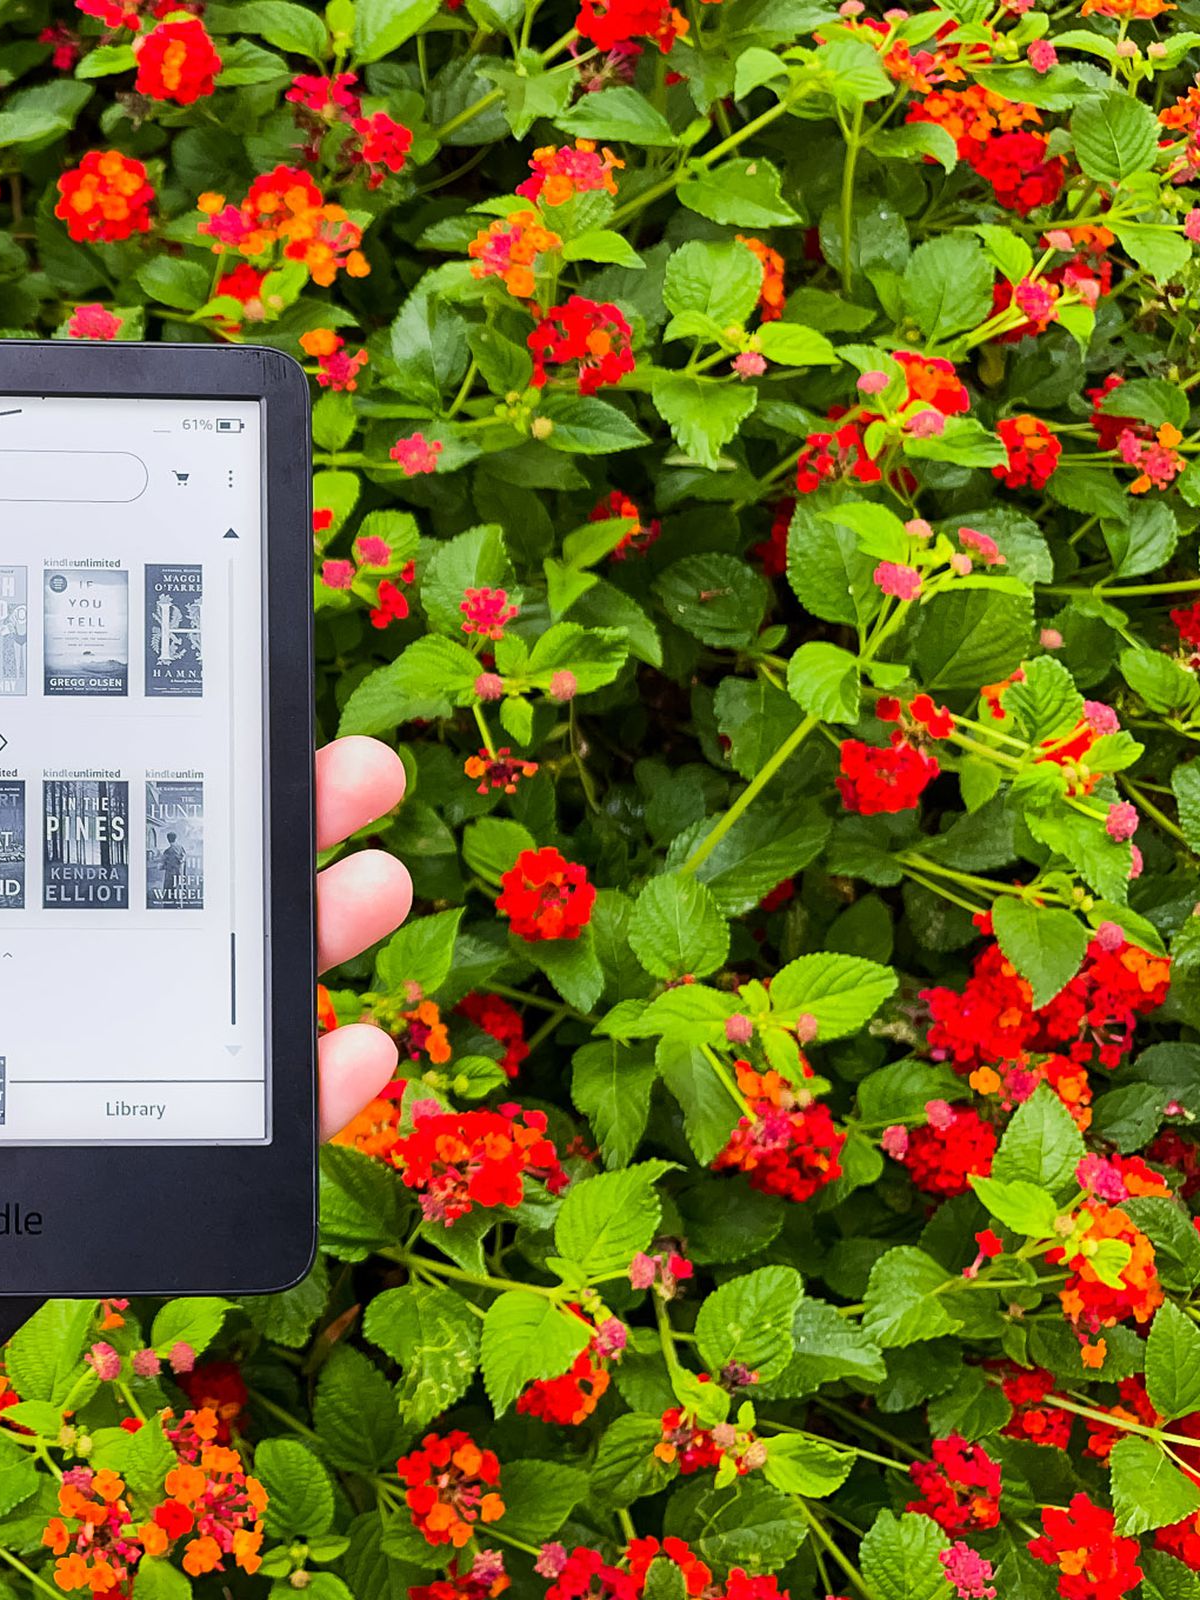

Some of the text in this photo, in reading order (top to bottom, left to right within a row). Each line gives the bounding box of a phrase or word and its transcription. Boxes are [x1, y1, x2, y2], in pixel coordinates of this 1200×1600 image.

[182, 419, 213, 430] 61%
[43, 559, 121, 568] kindleunlimited
[79, 580, 94, 589] IF
[69, 599, 102, 609] YOU
[67, 617, 105, 628] TELL
[153, 669, 202, 678] HAMN
[49, 678, 122, 687] GREGG OLSEN
[43, 769, 121, 778] kindleunlimited
[63, 797, 109, 811] IN THE
[46, 816, 125, 841] PINES
[51, 867, 119, 880] KENDRA
[45, 885, 125, 902] ELLIOT
[105, 1101, 166, 1120] Library
